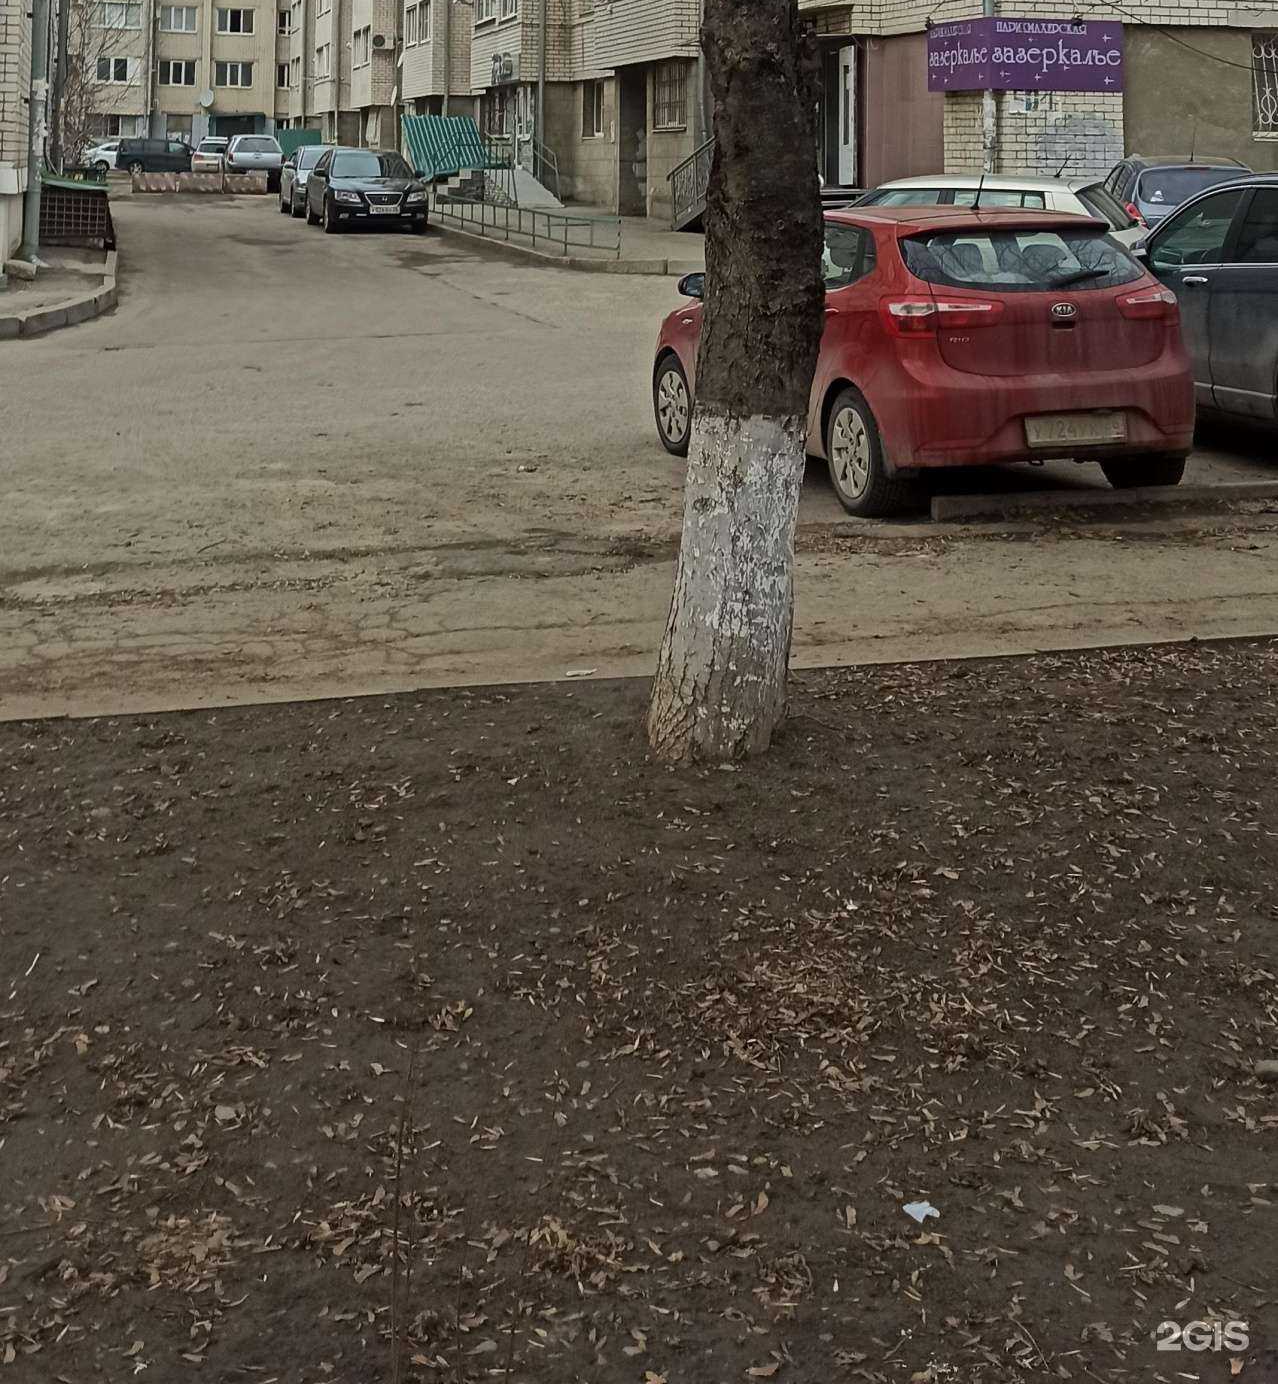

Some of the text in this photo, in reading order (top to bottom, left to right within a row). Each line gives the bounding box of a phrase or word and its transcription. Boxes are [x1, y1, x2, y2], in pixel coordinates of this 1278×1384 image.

[929, 40, 988, 74] зазеркалье
[992, 39, 1121, 72] зазеркалье
[1055, 305, 1073, 315] KIA
